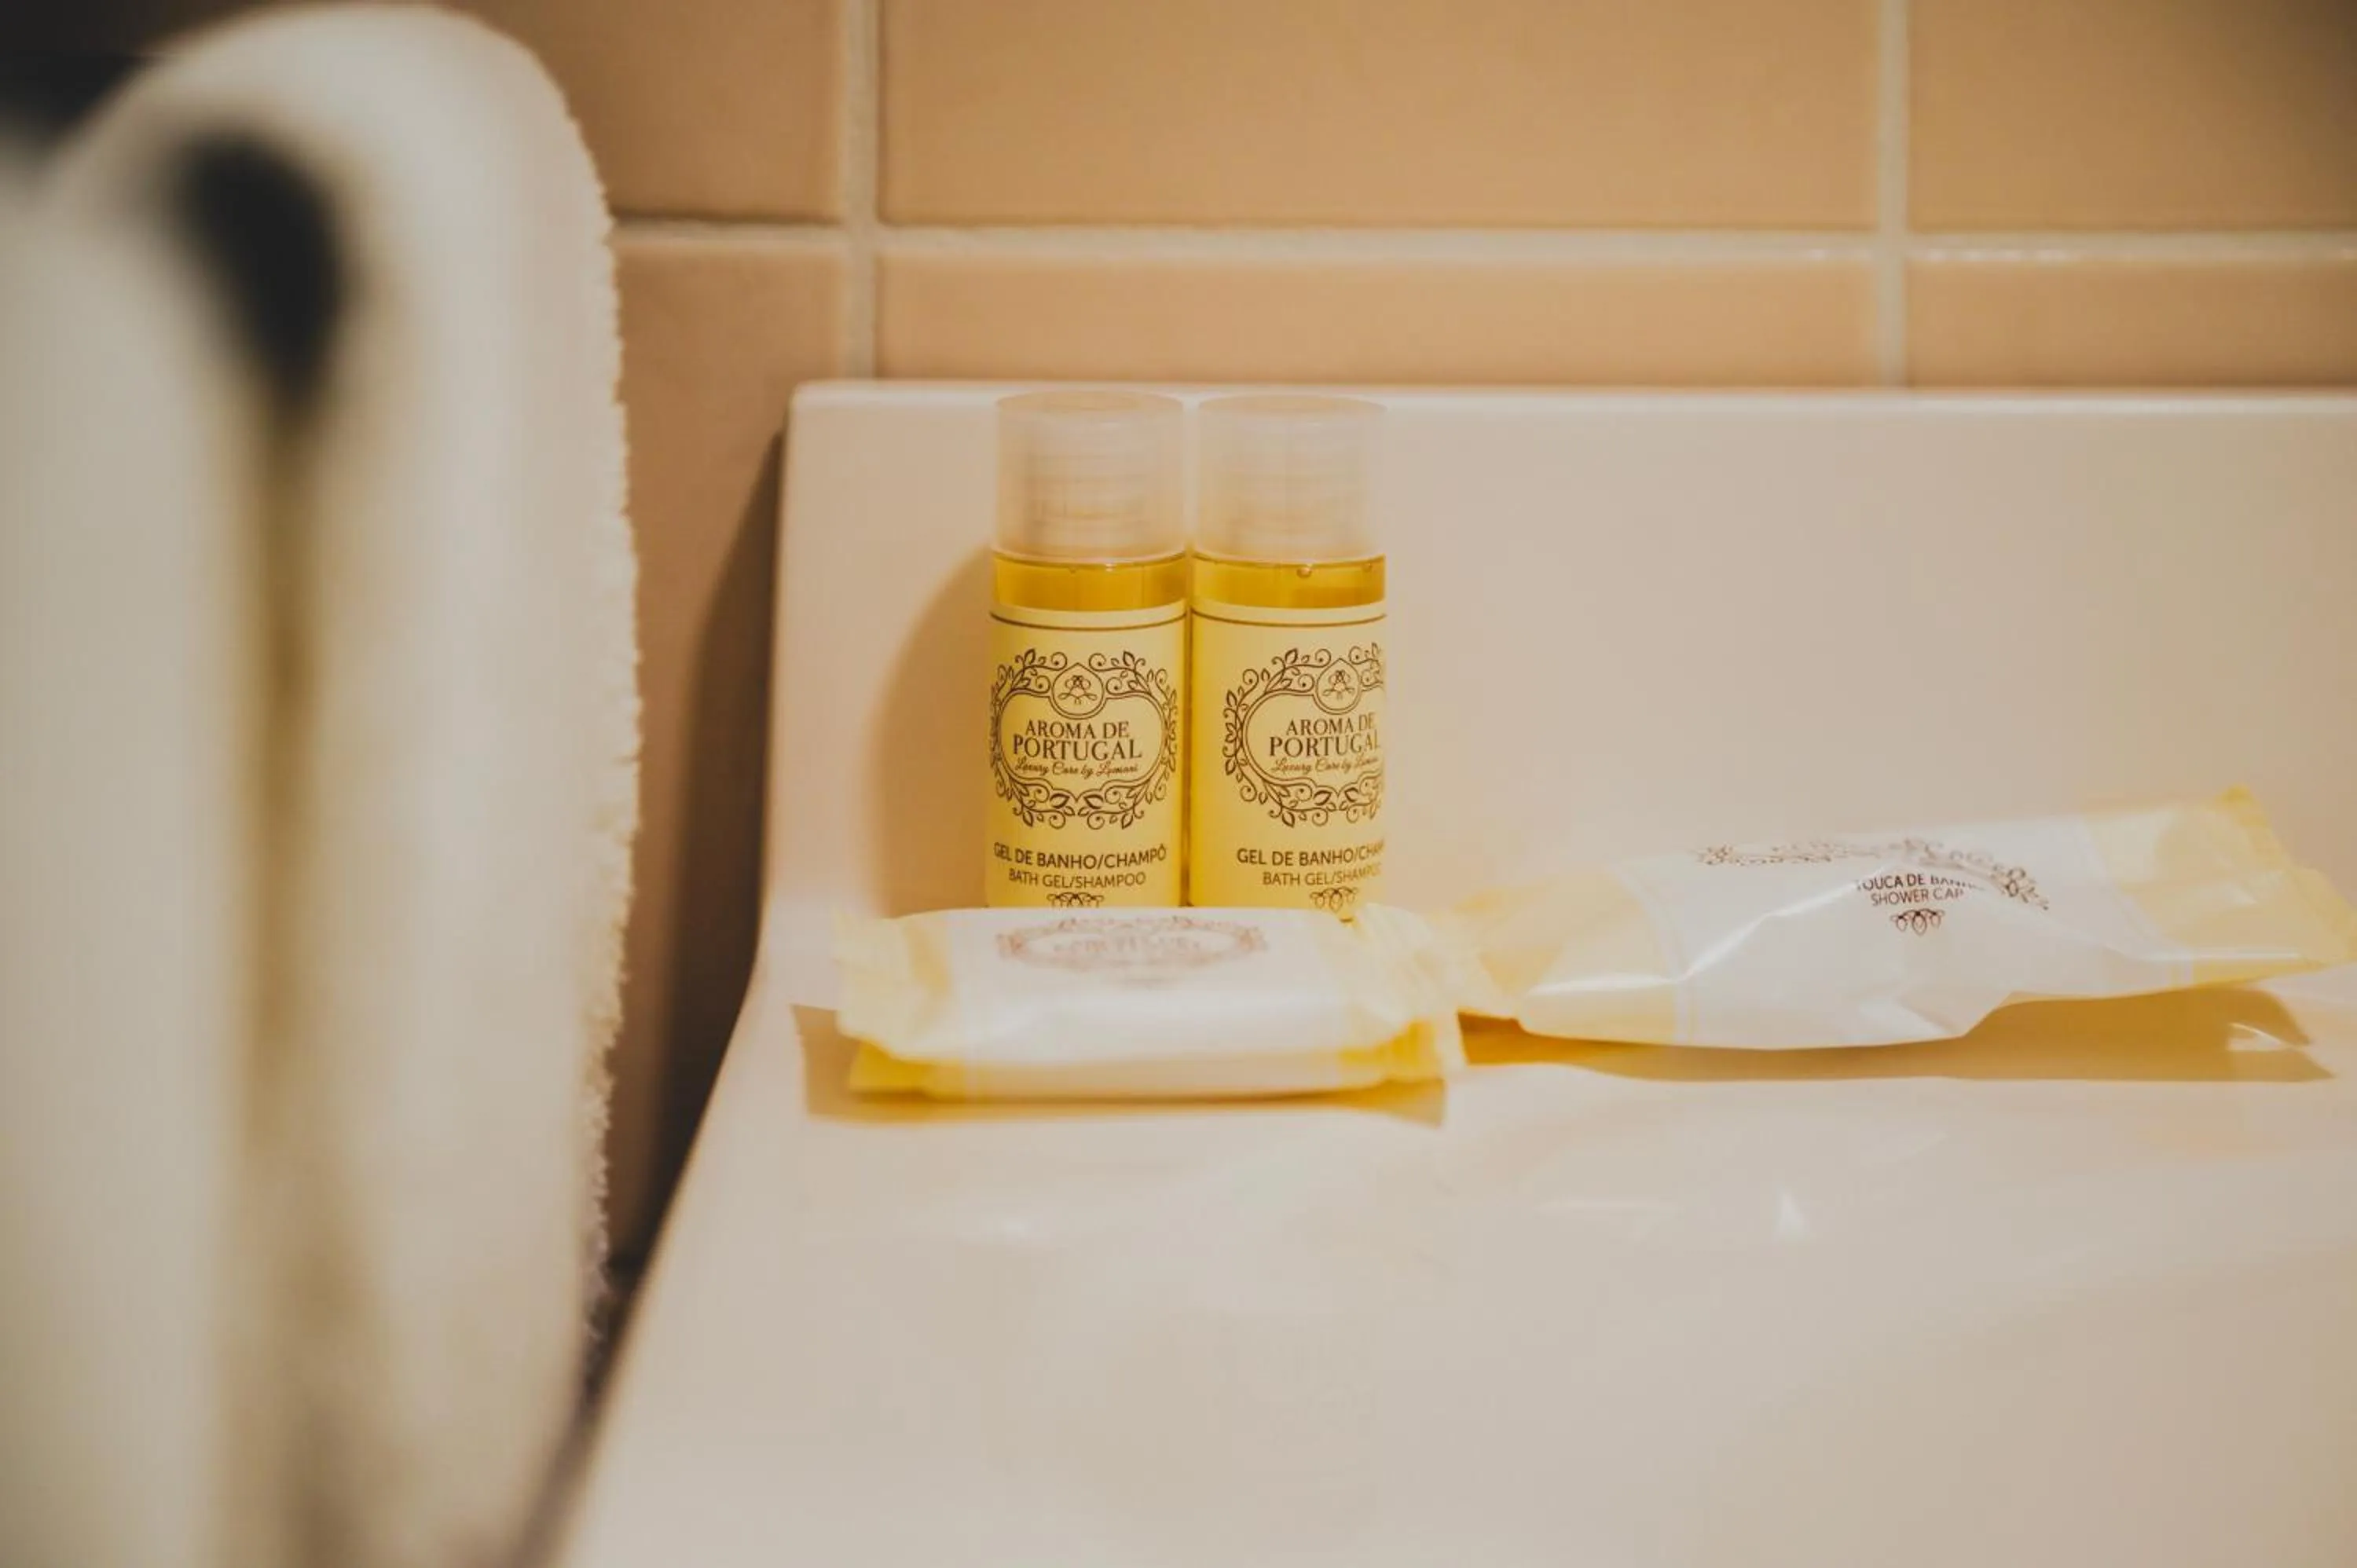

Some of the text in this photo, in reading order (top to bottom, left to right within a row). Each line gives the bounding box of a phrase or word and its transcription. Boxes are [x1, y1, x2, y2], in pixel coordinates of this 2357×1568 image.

[1025, 720, 1130, 739] AROMA DE
[1286, 712, 1376, 736] AROMA DE
[1013, 734, 1142, 760] PORTUGAL
[1269, 730, 1380, 758] PORTUGAL
[1080, 764, 1094, 779] by
[993, 842, 1012, 861] GEL
[1014, 848, 1033, 865] DE
[1237, 848, 1266, 865] GEL
[1272, 851, 1294, 866] DE
[1009, 868, 1146, 888] BATH GEL/SHAMPOO
[1263, 871, 1300, 886] BATH
[1907, 874, 1925, 887] DE
[1871, 889, 1929, 906] SHOWER
